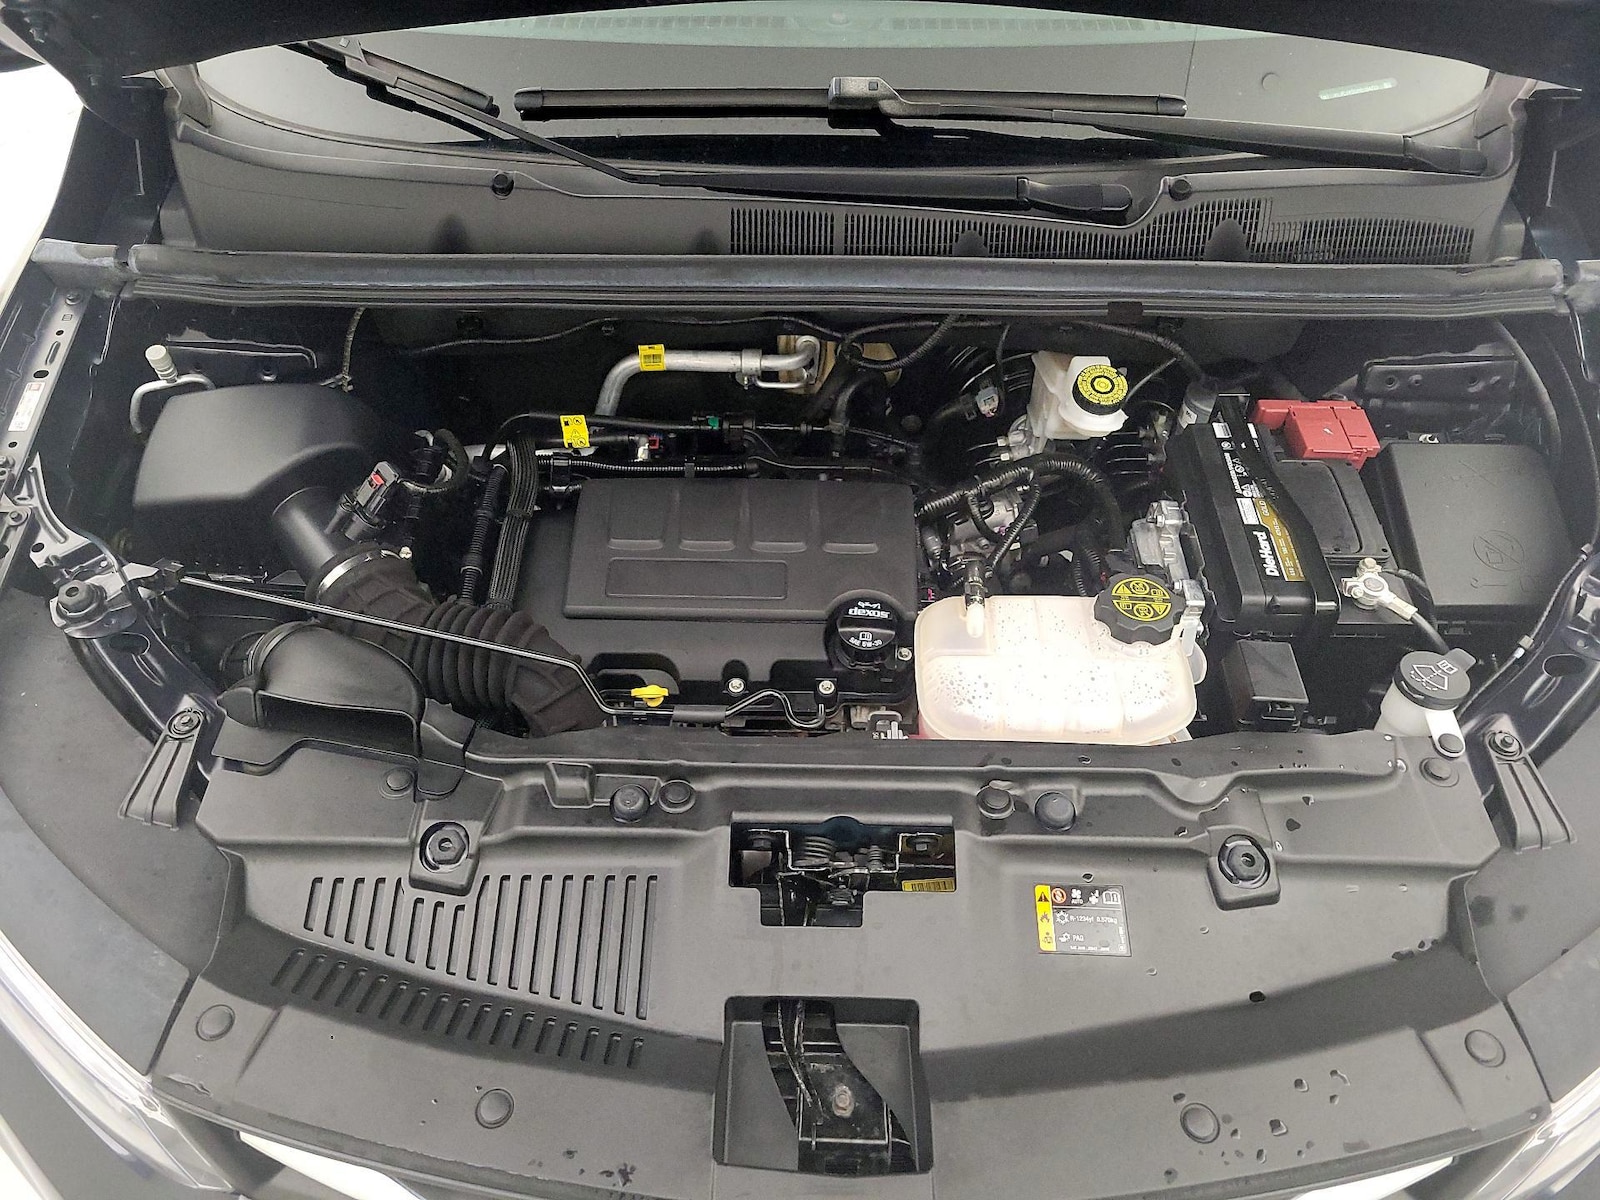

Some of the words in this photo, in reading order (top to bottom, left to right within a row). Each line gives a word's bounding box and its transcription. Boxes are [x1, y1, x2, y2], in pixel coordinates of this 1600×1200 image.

[1259, 500, 1270, 516] GOLD
[1253, 531, 1280, 577] DieHard
[848, 607, 890, 618] dexos
